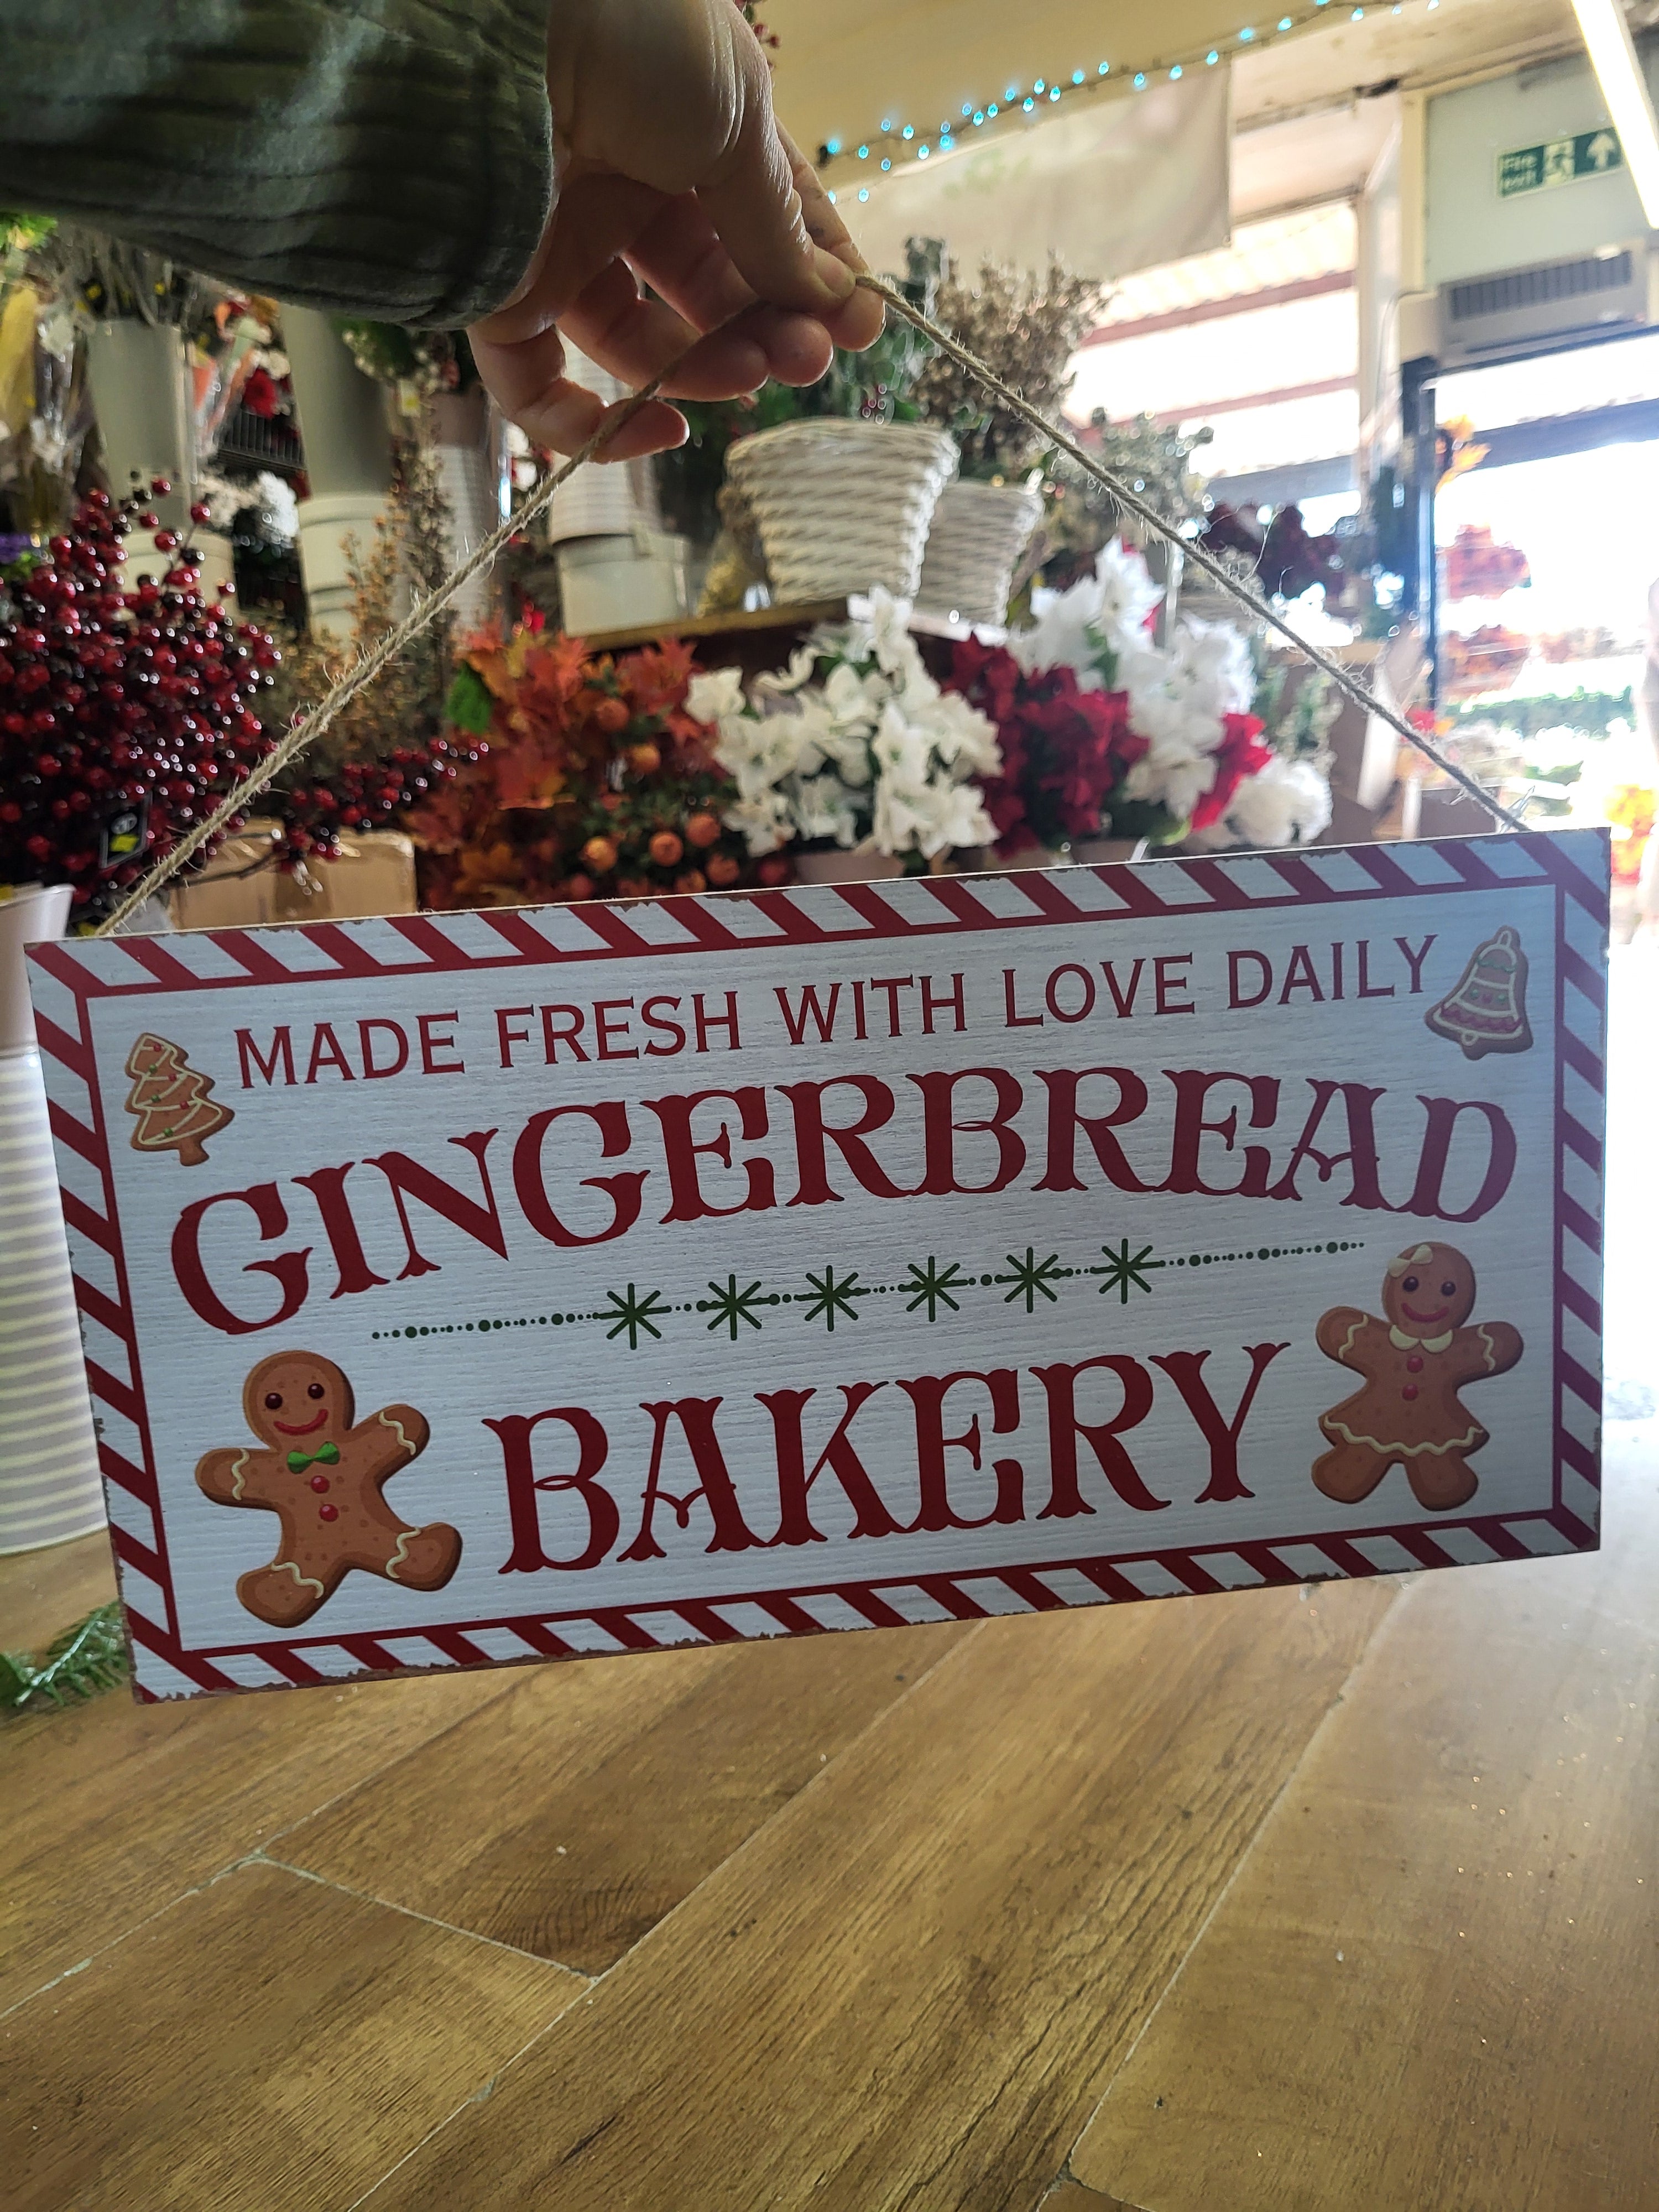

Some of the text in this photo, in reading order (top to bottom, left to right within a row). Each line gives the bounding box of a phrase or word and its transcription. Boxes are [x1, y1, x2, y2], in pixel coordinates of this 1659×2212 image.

[236, 933, 1438, 1089] MADE FRESH WITH LOVE DAILY
[170, 1066, 1517, 1334] GINGERBREAD
[482, 1342, 1291, 1573] BAKERY
